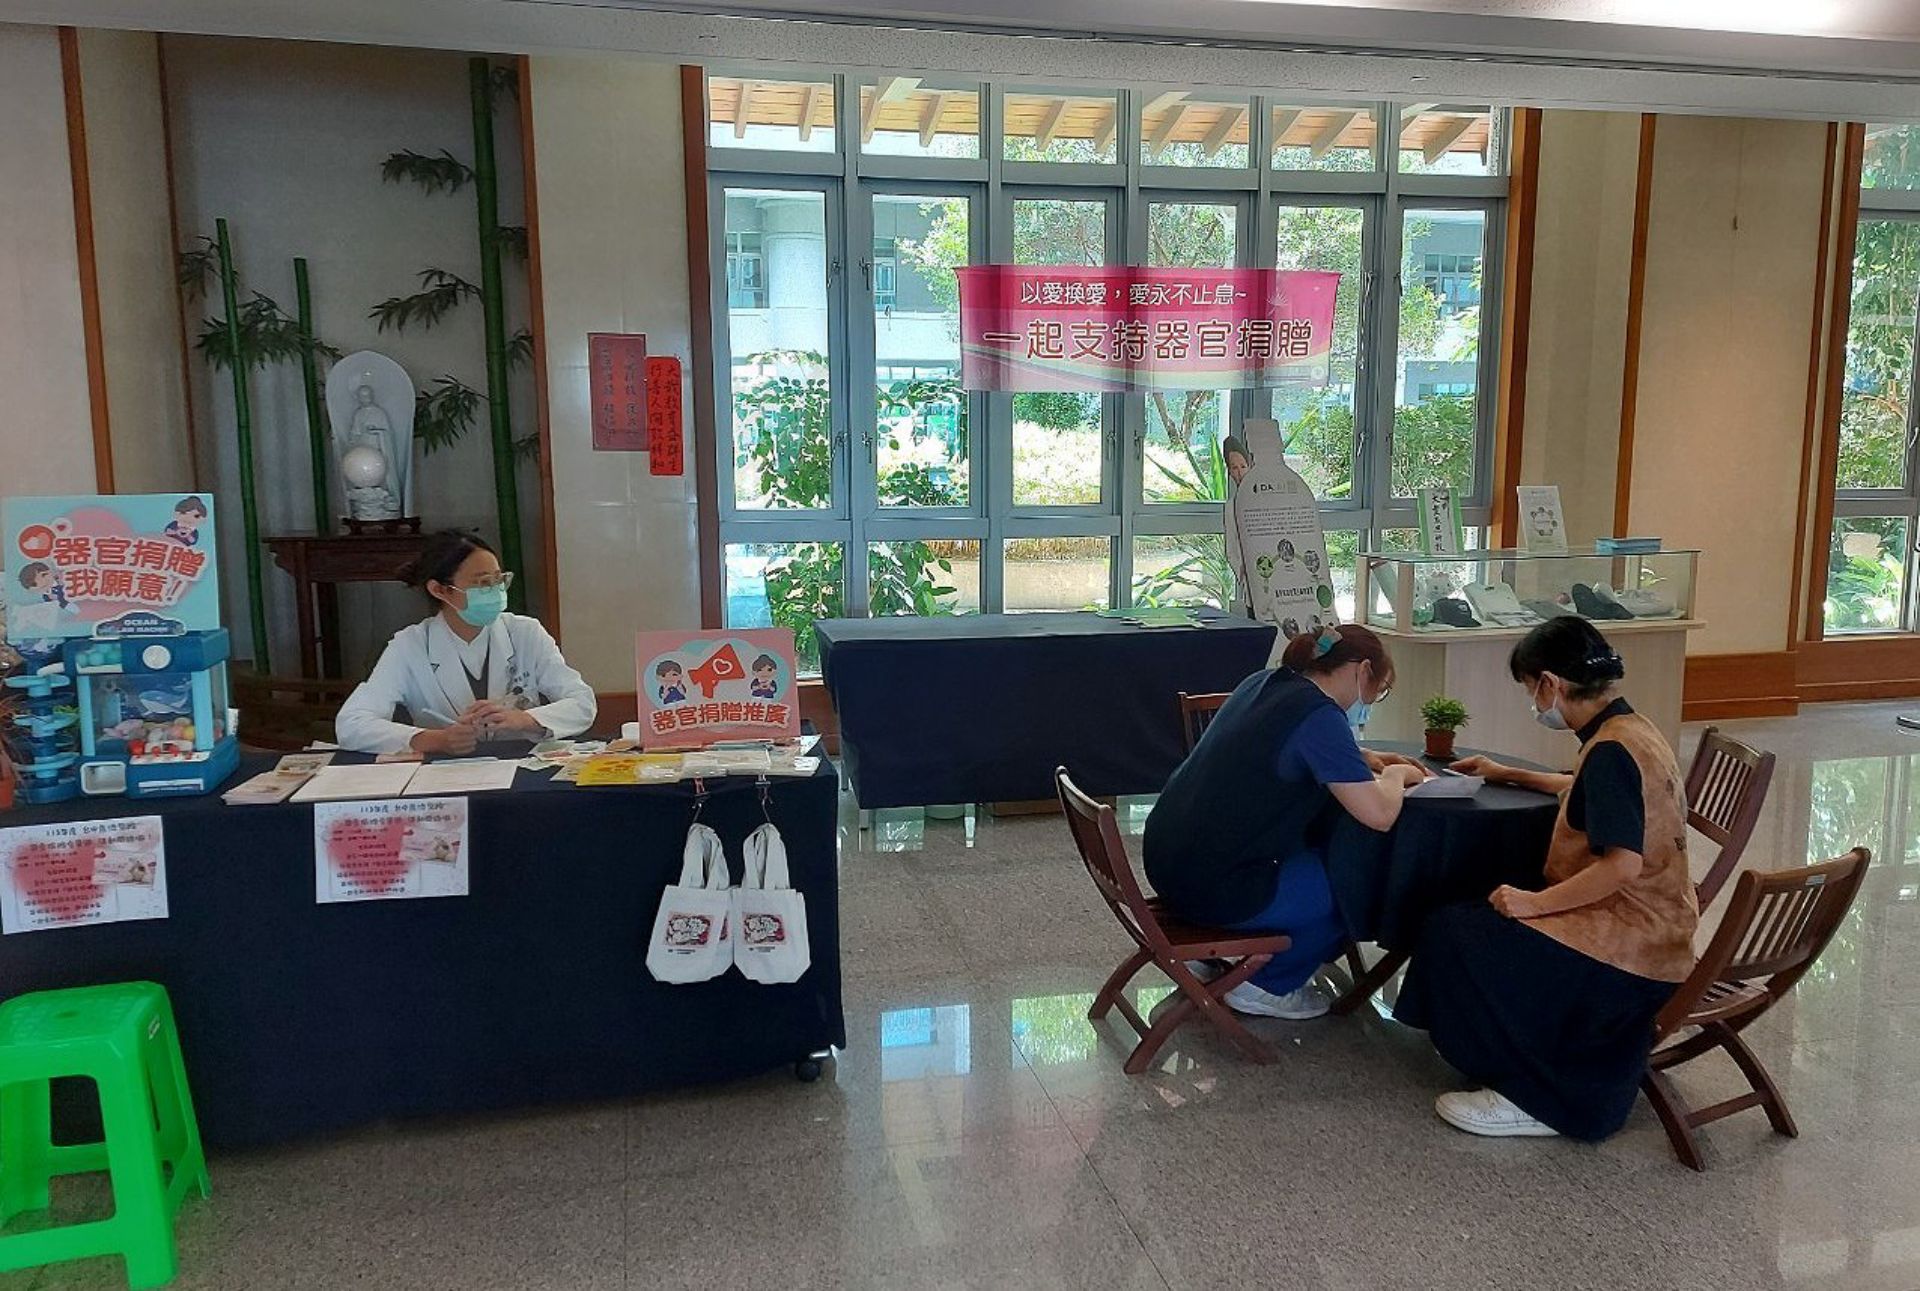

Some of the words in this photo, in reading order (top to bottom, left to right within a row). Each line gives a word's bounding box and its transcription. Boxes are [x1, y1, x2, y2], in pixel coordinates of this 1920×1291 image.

[1021, 281, 1247, 305] 以愛換愛，愛永不止息~
[983, 318, 1313, 362] 一起支持器官捐贈
[54, 537, 205, 578] 器官捐贈
[653, 702, 789, 731] 器官捐贈推廣
